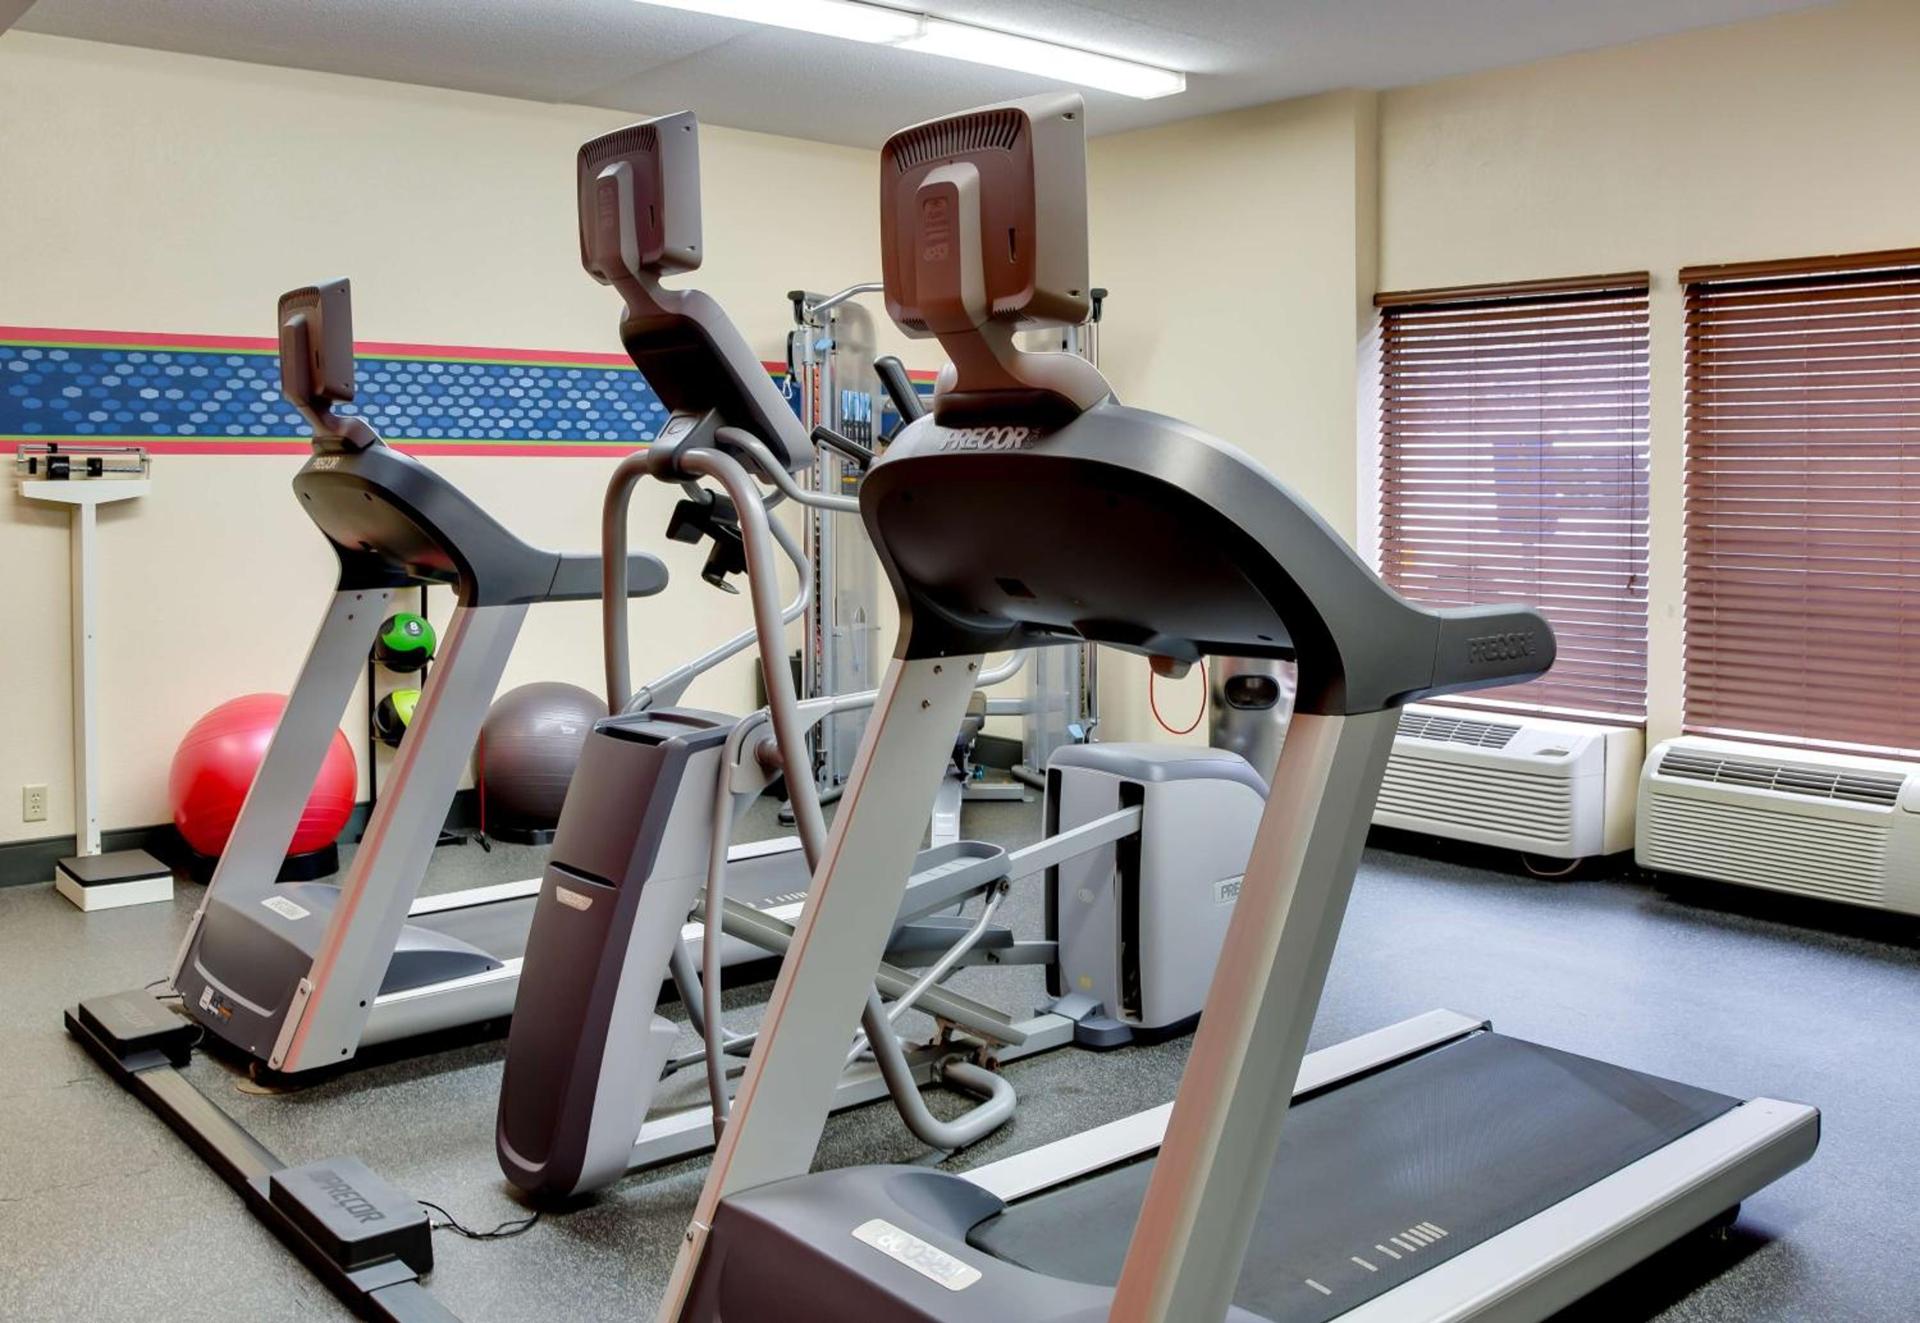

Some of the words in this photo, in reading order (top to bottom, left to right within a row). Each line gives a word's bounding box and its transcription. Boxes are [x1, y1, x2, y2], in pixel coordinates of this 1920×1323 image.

[940, 426, 1030, 450] PRECOR
[1467, 632, 1528, 664] PRECOR
[320, 1175, 386, 1224] PRECOR
